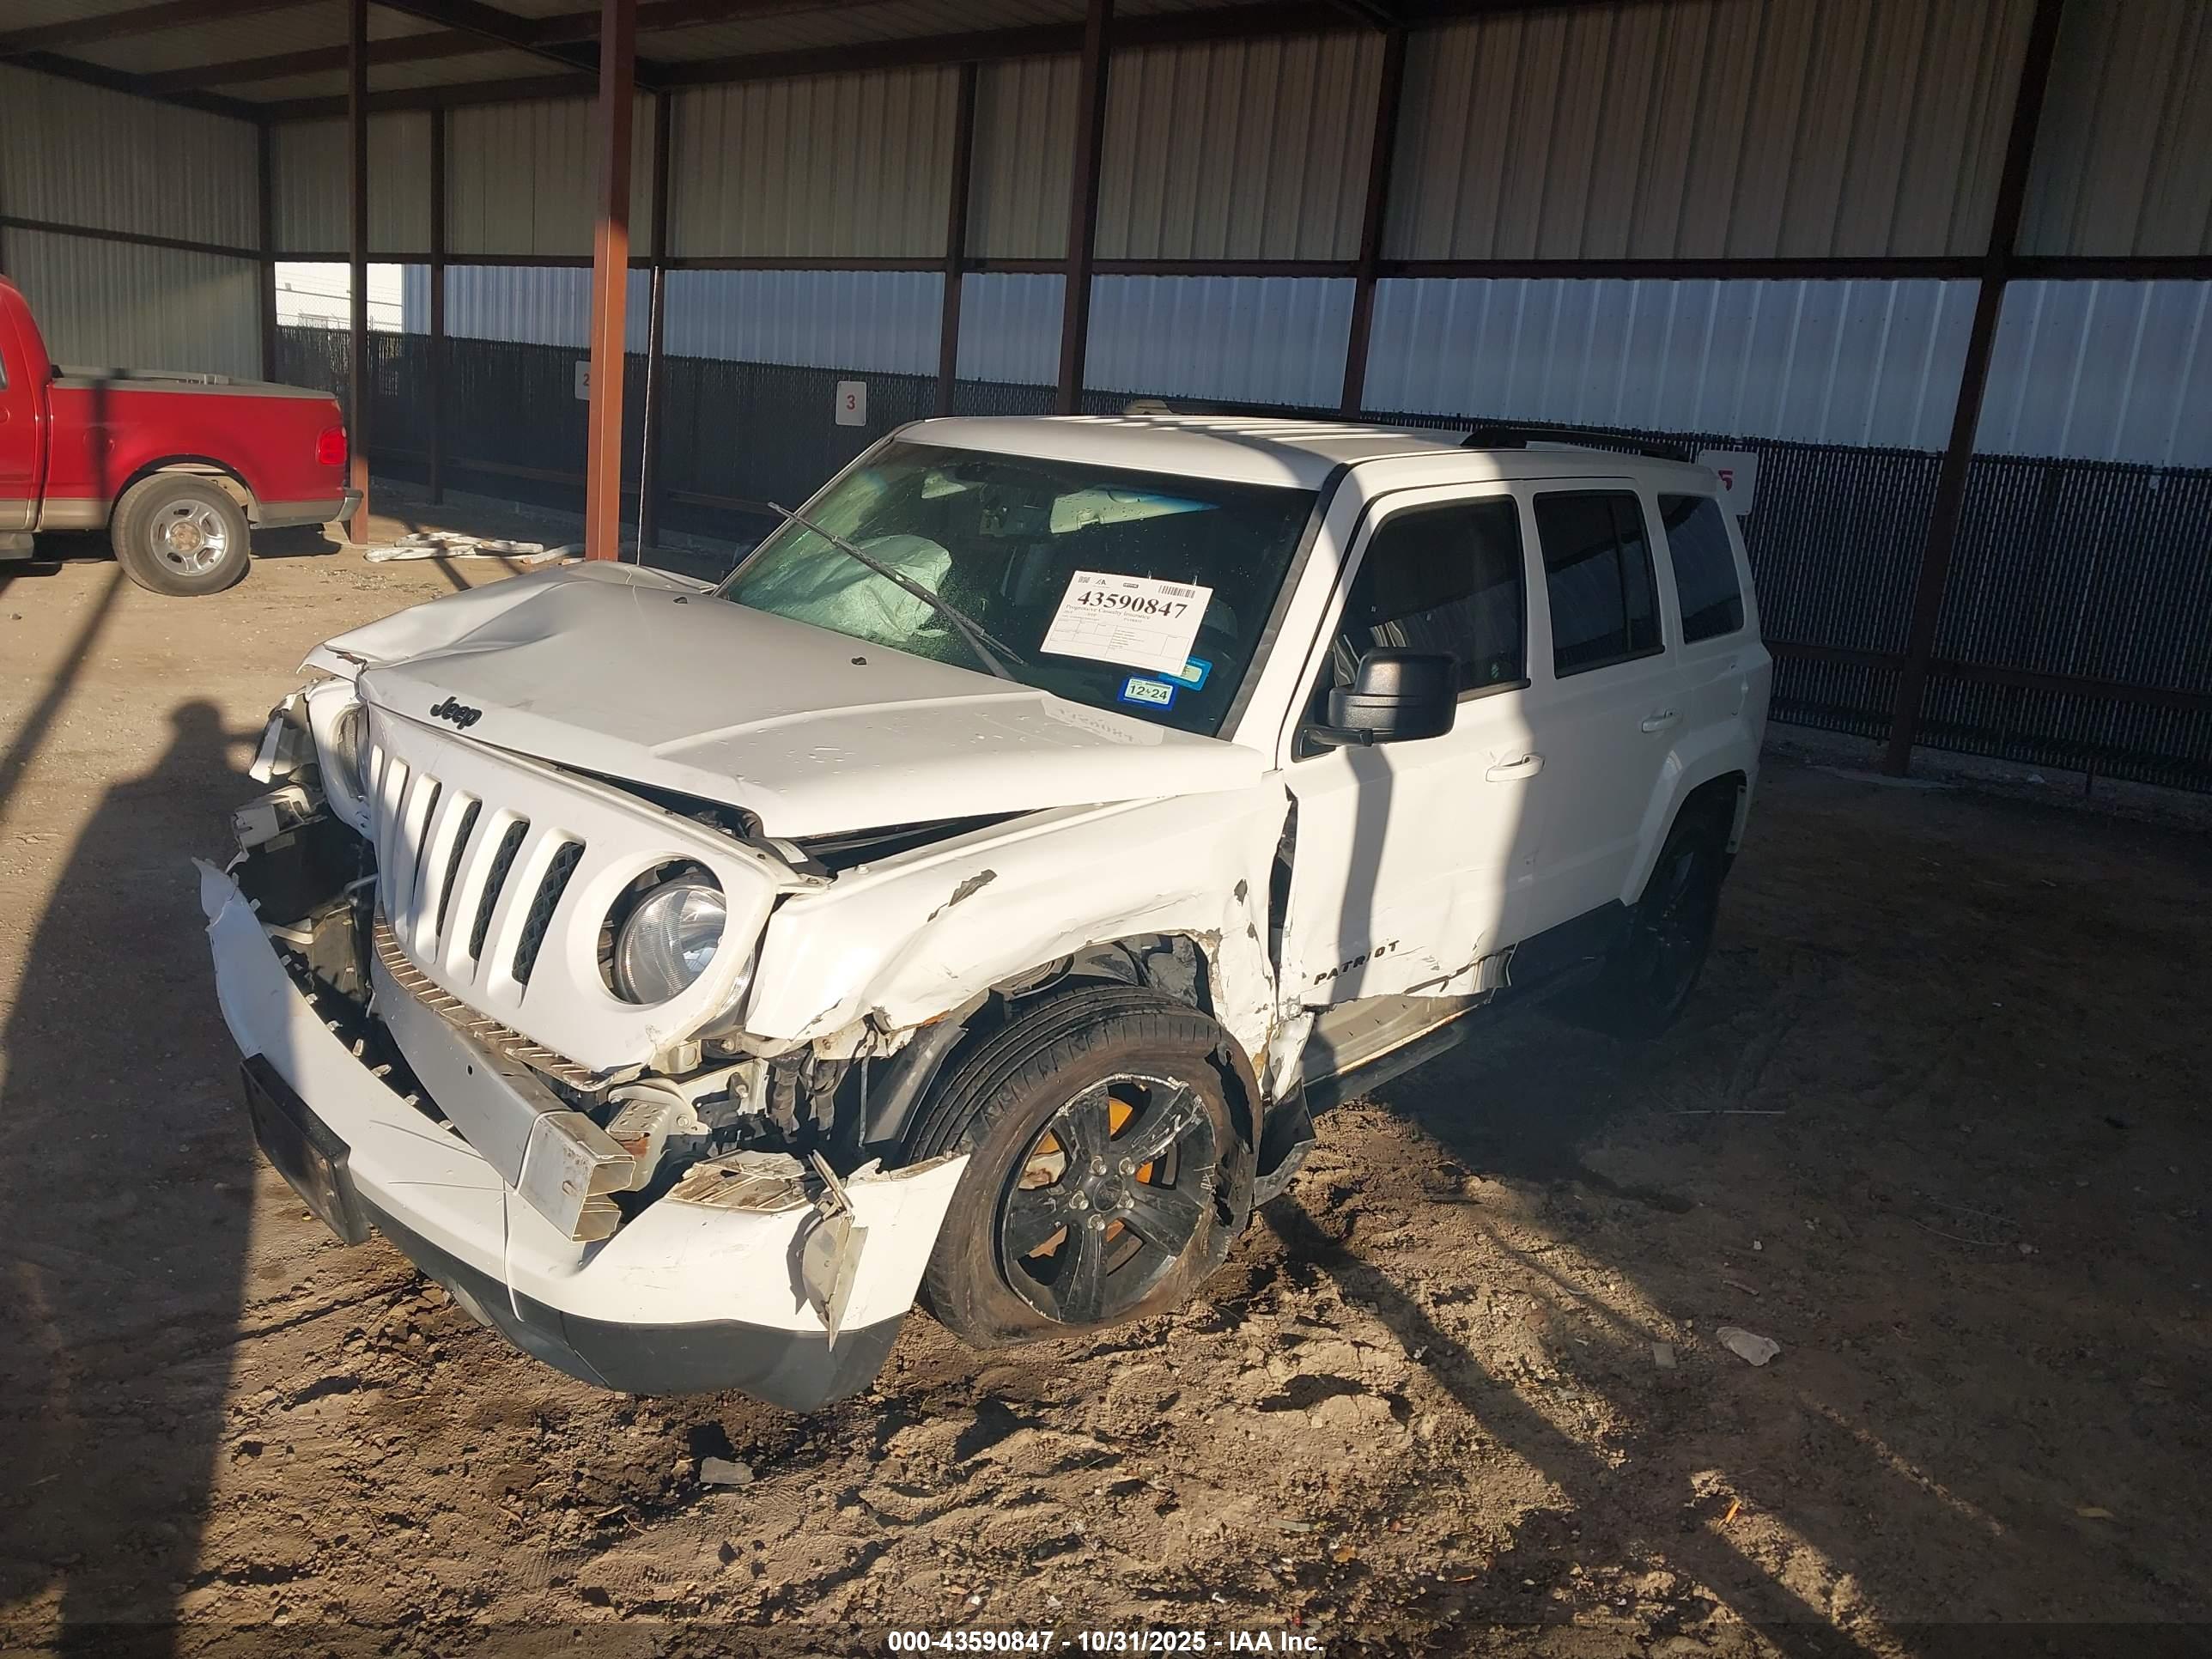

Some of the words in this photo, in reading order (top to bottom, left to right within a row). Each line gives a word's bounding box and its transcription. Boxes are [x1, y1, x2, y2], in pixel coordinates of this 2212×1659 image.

[583, 373, 590, 386] 2
[846, 394, 855, 410] 3
[1718, 470, 1733, 491] 5
[1077, 590, 1188, 619] 43590847
[1130, 684, 1146, 696] 12
[1151, 689, 1168, 700] 24
[429, 696, 483, 730] Jeep
[1313, 939, 1401, 986] PATRIOT
